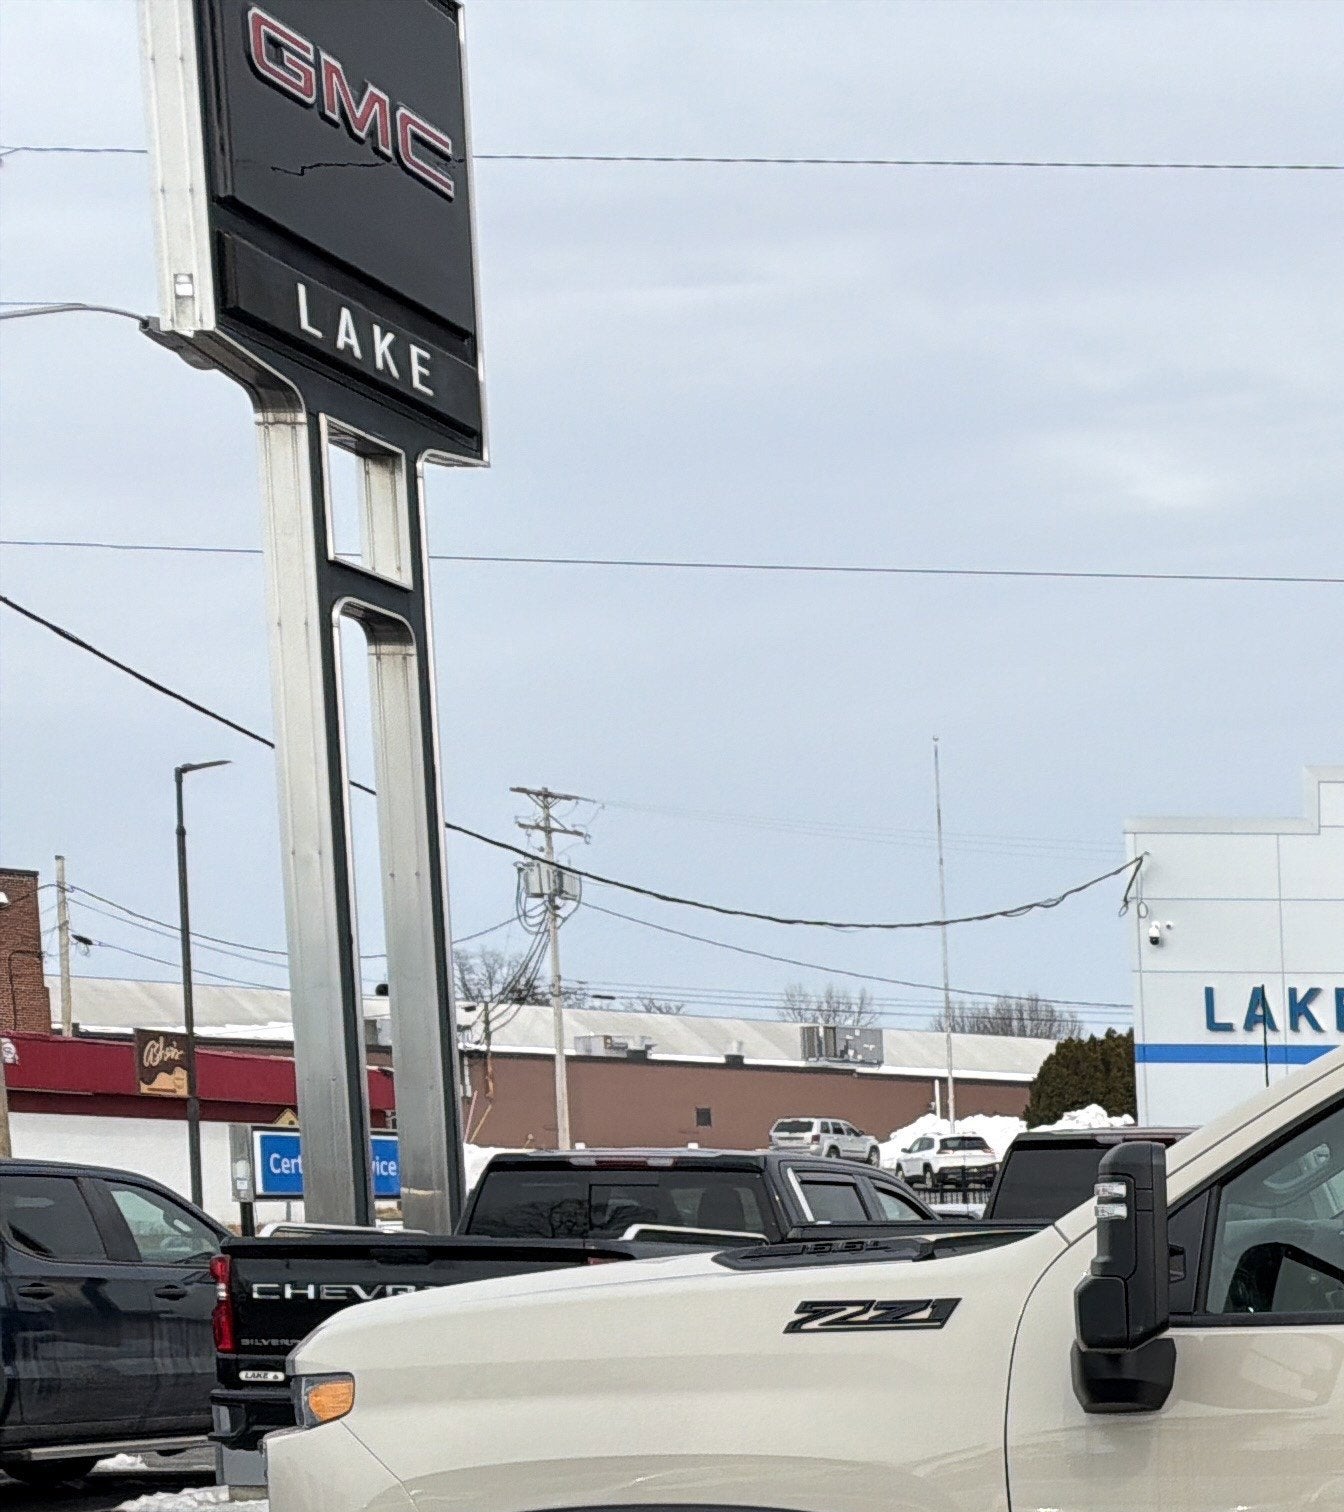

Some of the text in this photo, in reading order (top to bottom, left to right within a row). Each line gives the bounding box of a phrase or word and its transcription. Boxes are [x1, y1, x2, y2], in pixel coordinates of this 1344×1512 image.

[248, 6, 454, 198] GMC
[297, 282, 434, 397] LAKE
[783, 1298, 963, 1334] Z71
